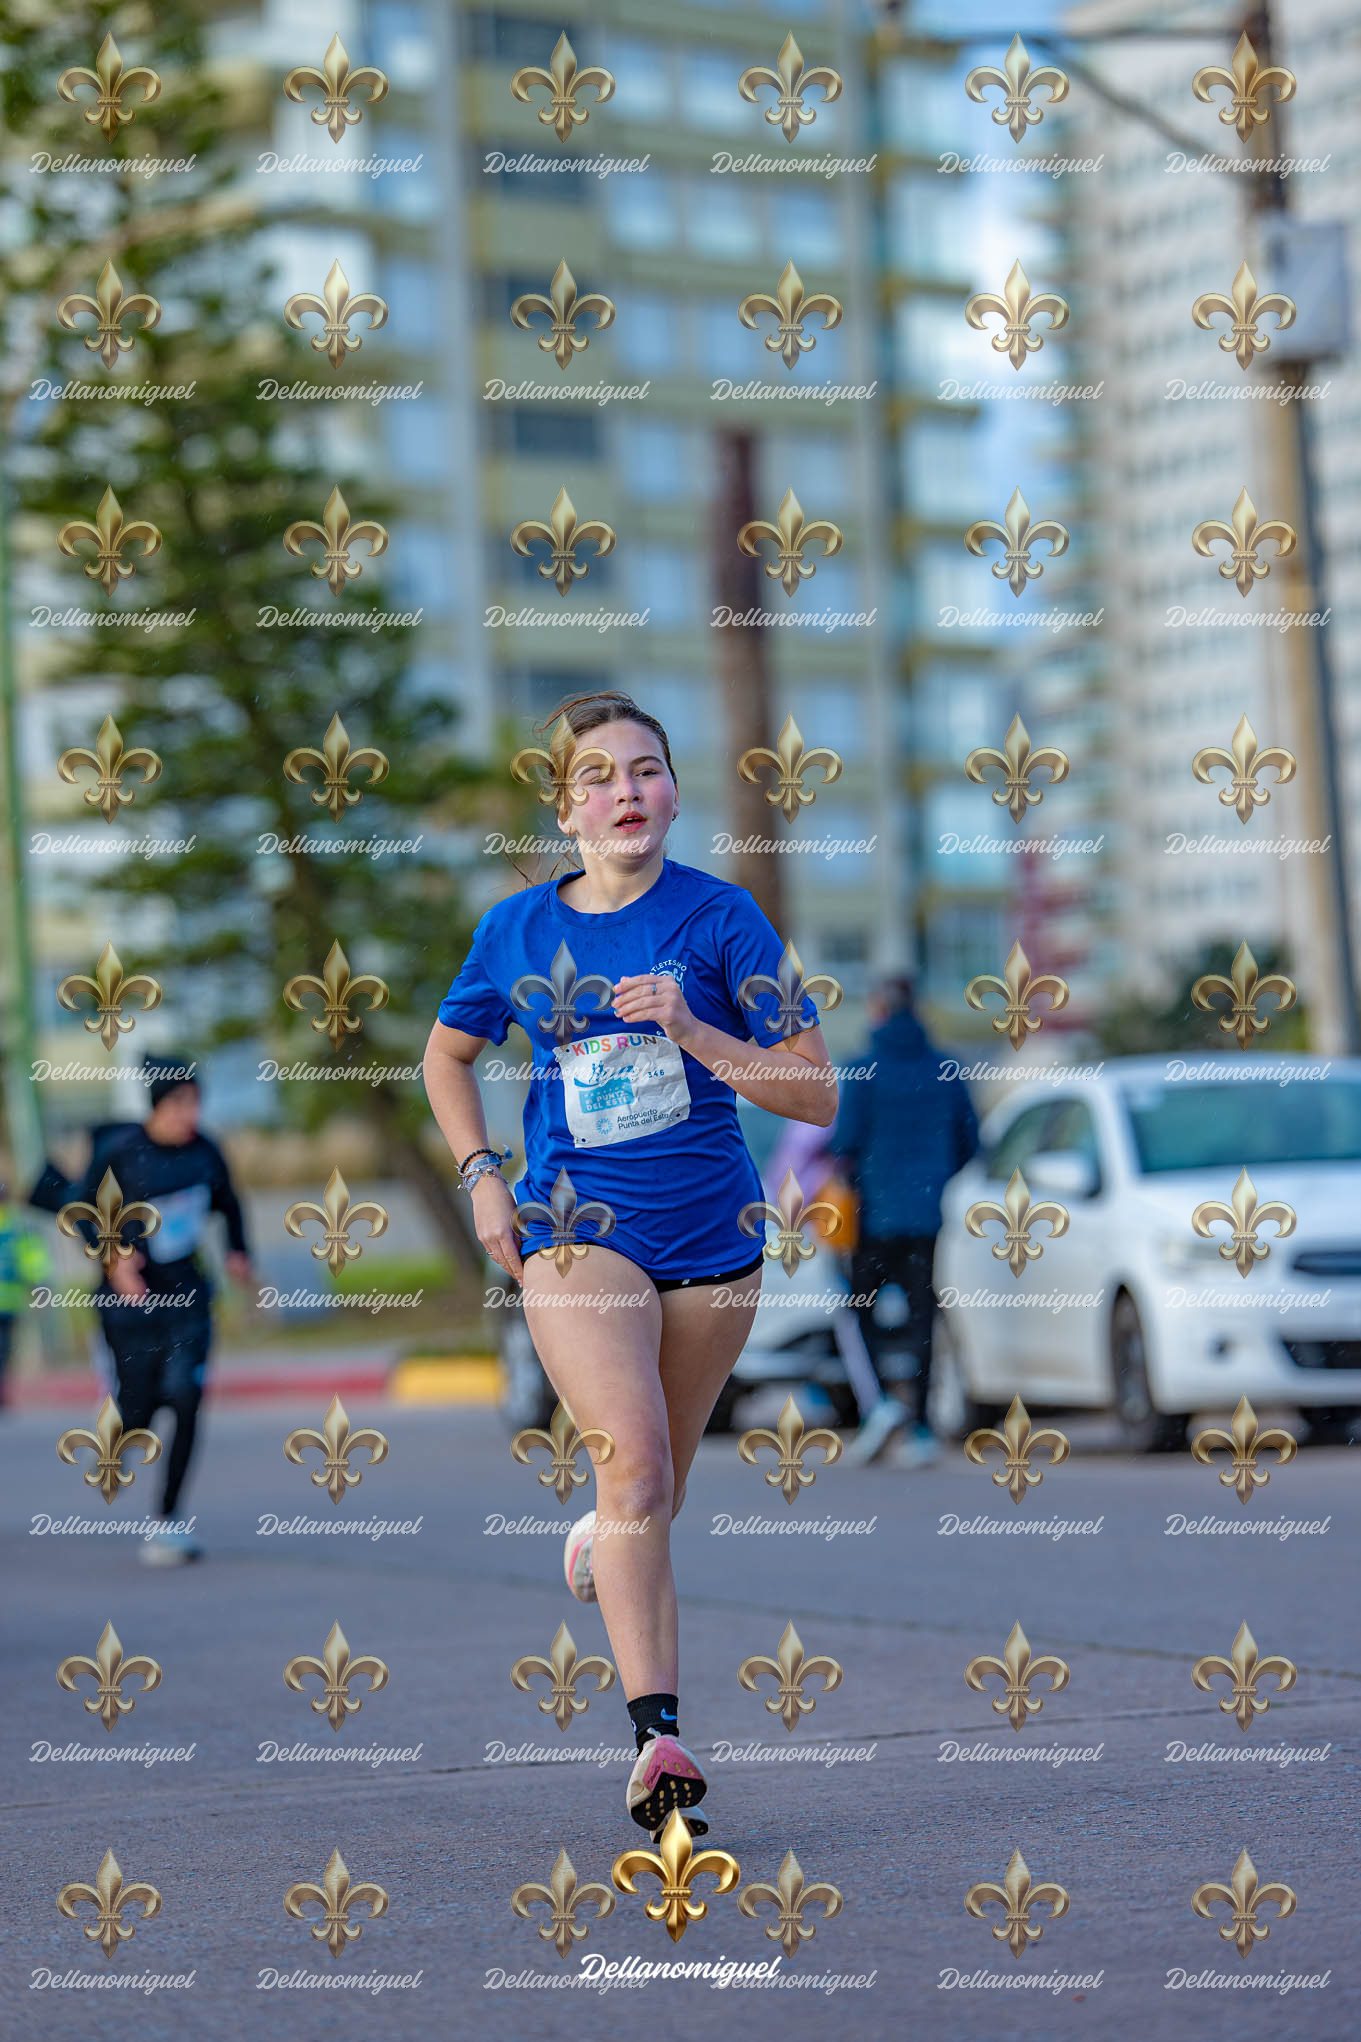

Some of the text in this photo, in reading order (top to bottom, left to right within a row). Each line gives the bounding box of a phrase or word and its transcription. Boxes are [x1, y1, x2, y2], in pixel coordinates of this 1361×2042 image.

[650, 959, 687, 975] TLETISMO
[571, 1035, 657, 1056] KIDS RUN
[617, 1108, 657, 1122] Aeropuerto
[617, 1120, 640, 1130] Punta
[640, 1116, 653, 1125] del
